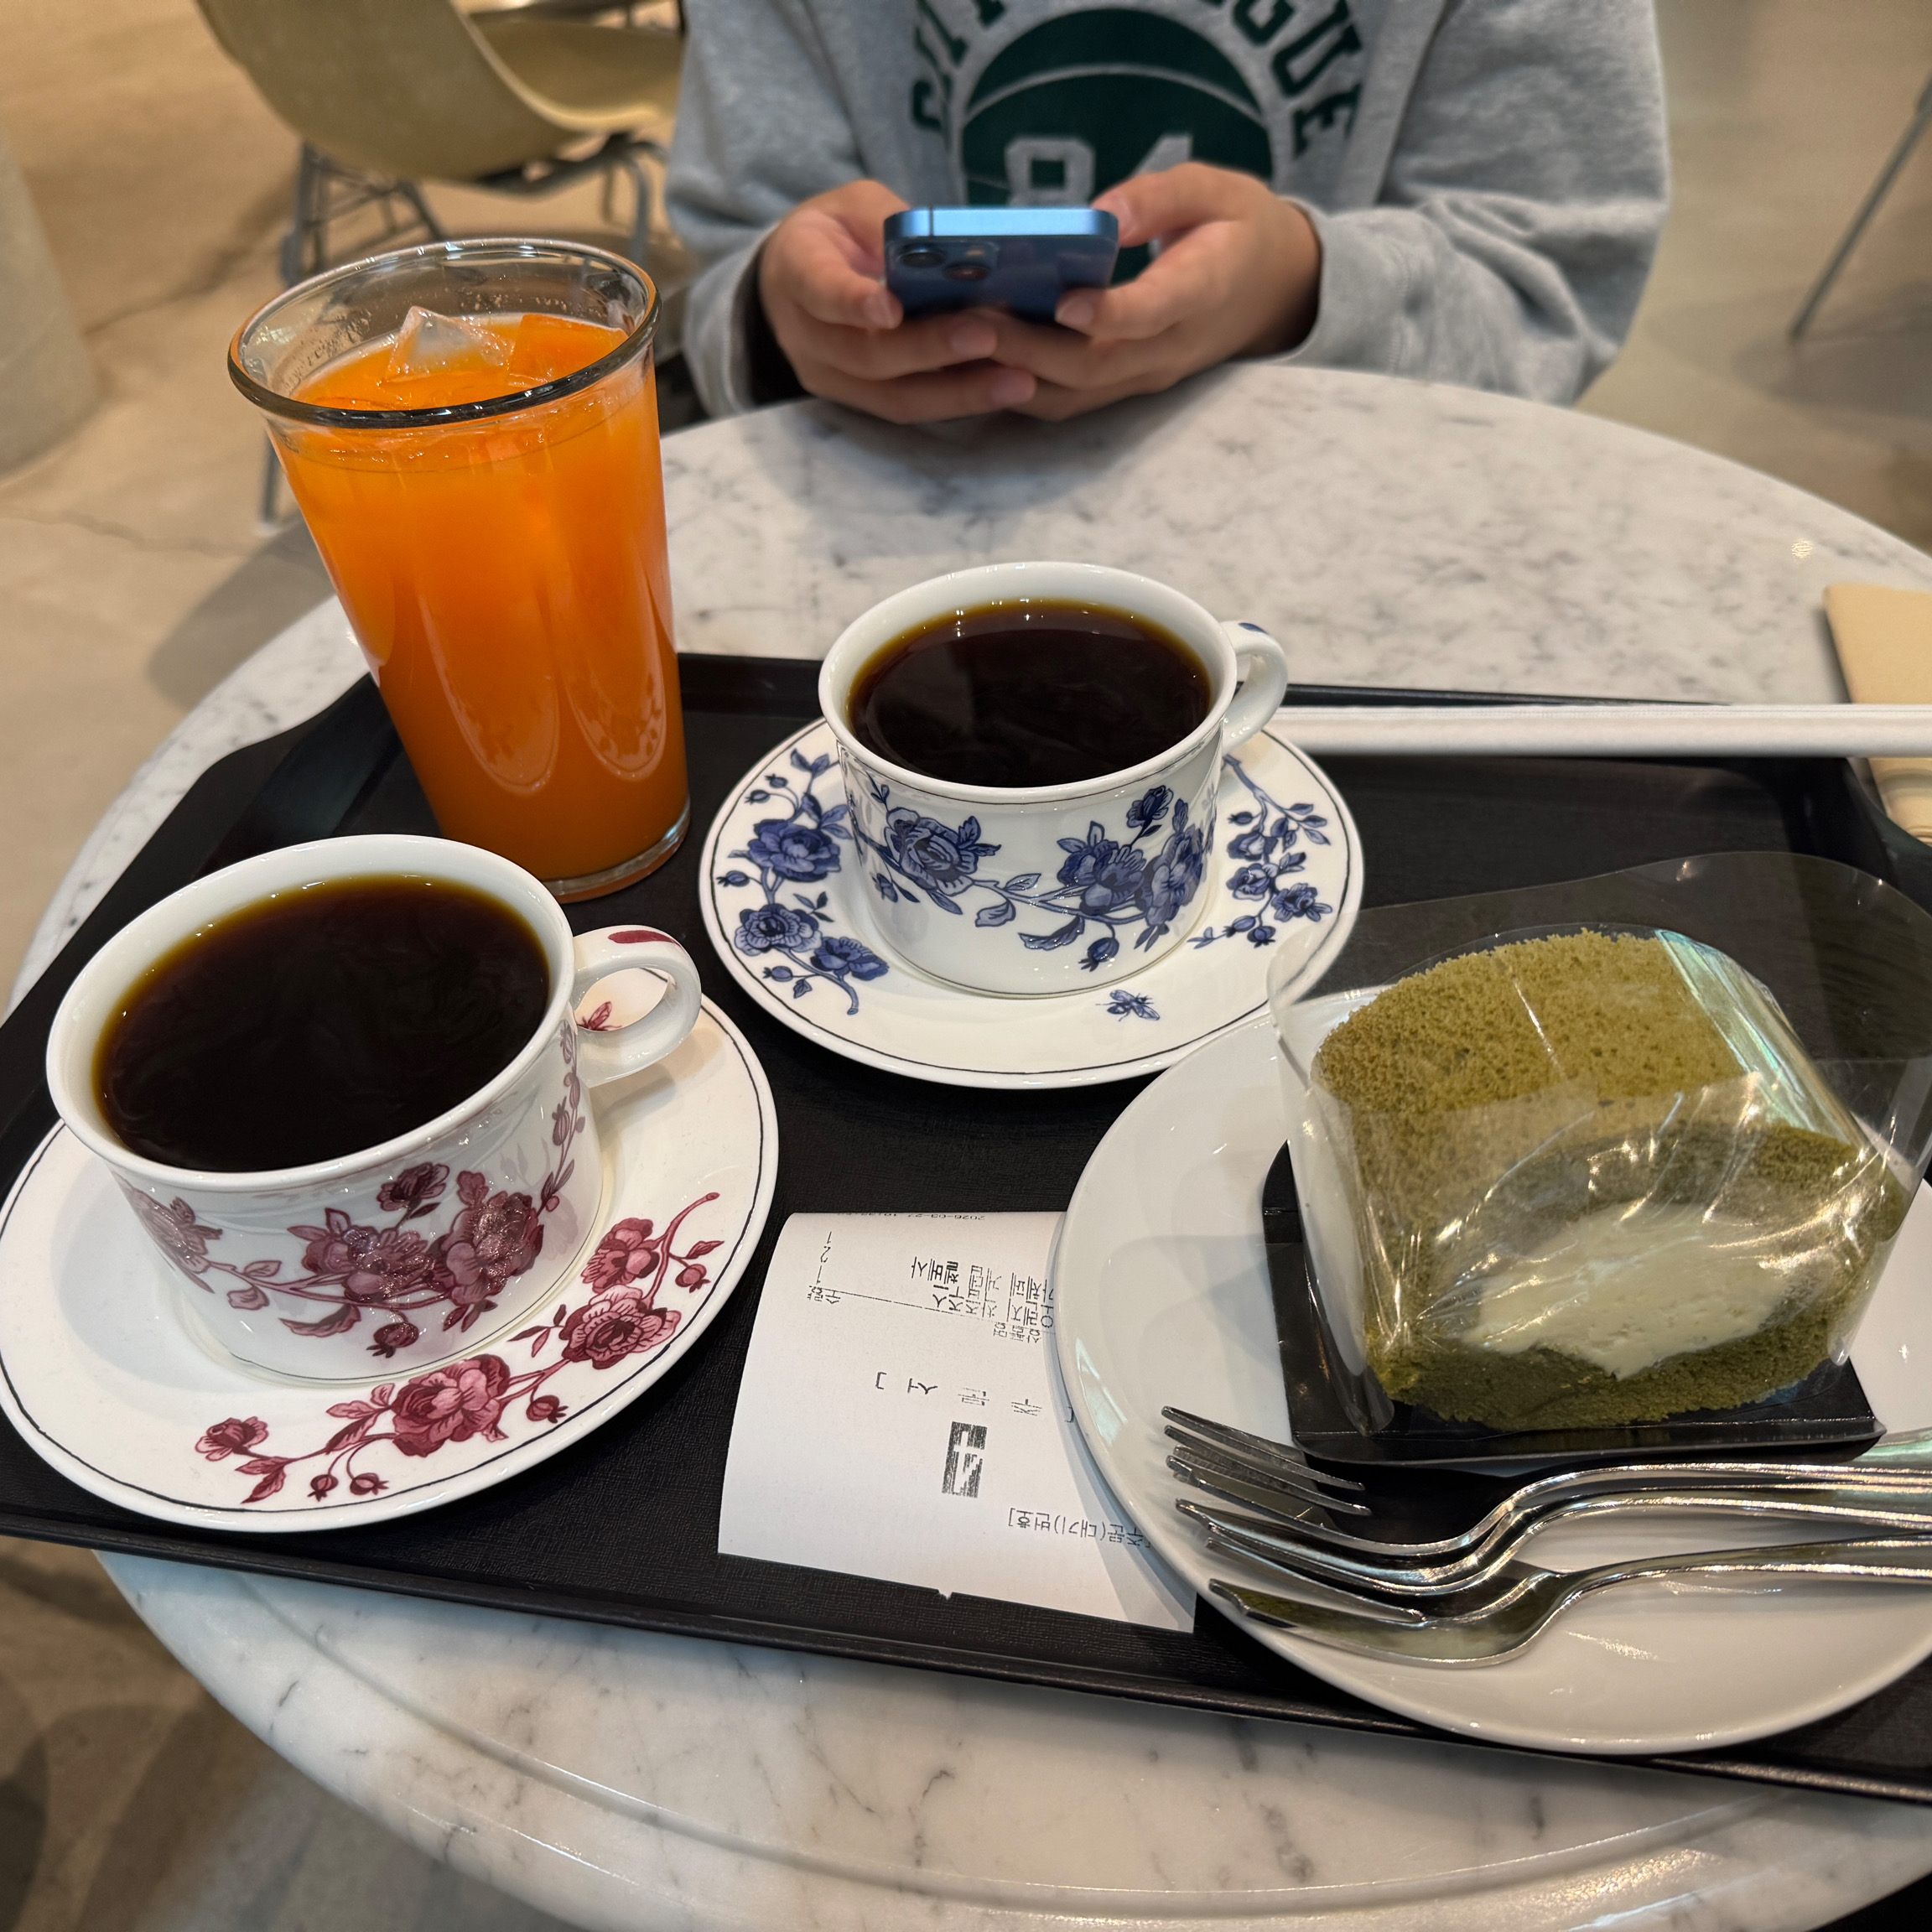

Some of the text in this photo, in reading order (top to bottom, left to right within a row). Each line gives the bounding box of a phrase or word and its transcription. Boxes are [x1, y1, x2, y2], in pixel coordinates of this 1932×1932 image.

[807, 1285, 1041, 1343] 상품명 수량
[945, 1425, 987, 1497] 4
